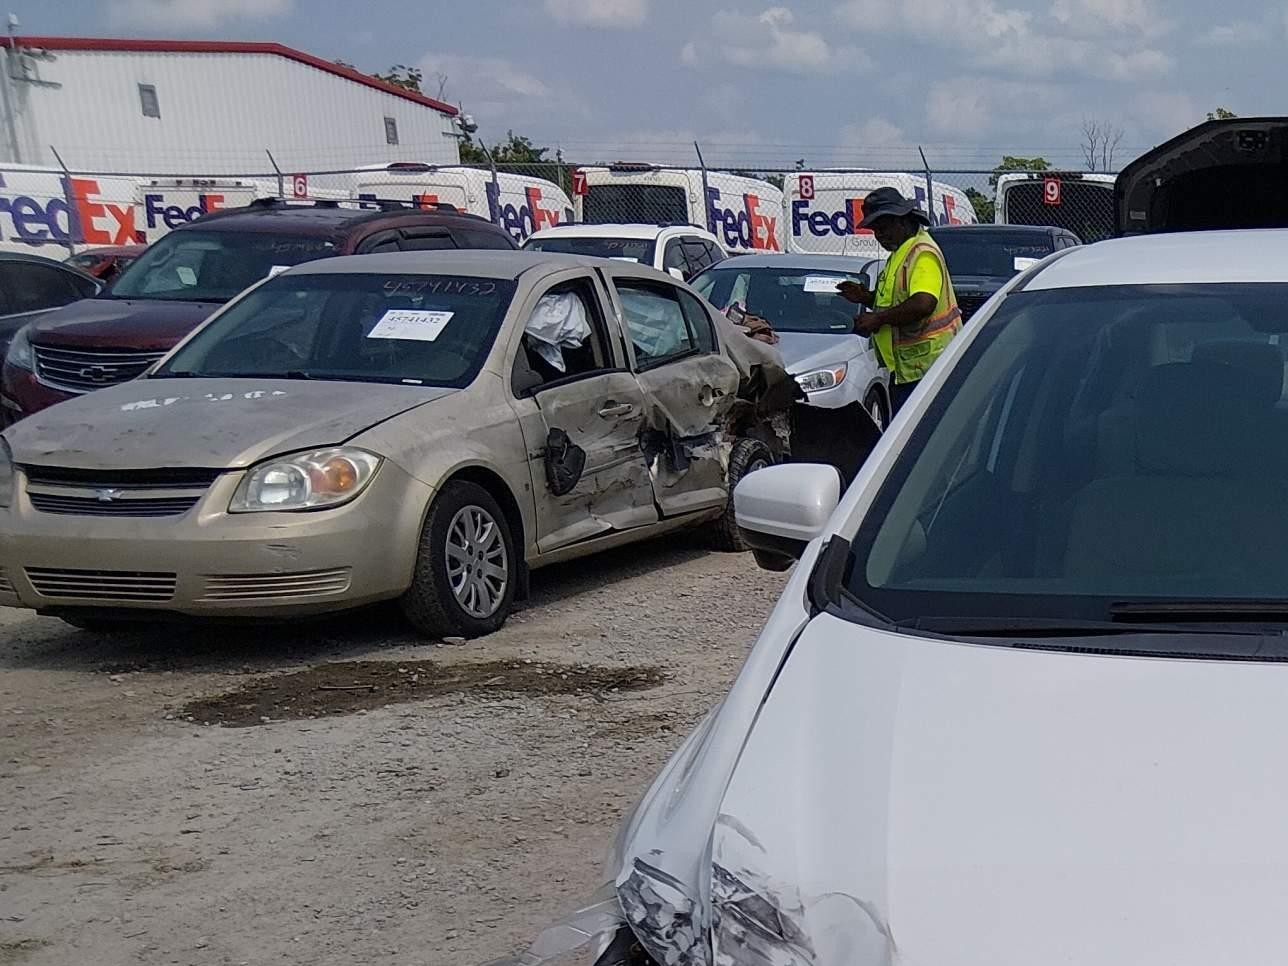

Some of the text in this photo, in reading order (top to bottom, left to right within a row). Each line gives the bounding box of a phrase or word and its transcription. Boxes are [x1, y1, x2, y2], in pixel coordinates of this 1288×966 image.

[294, 177, 306, 196] 6
[575, 174, 585, 193] 7
[801, 178, 813, 198] 8
[1046, 182, 1059, 201] 9
[0, 172, 147, 247] edEx
[145, 194, 224, 229] FedE
[706, 186, 780, 251] FedEx
[792, 198, 875, 237] FedE
